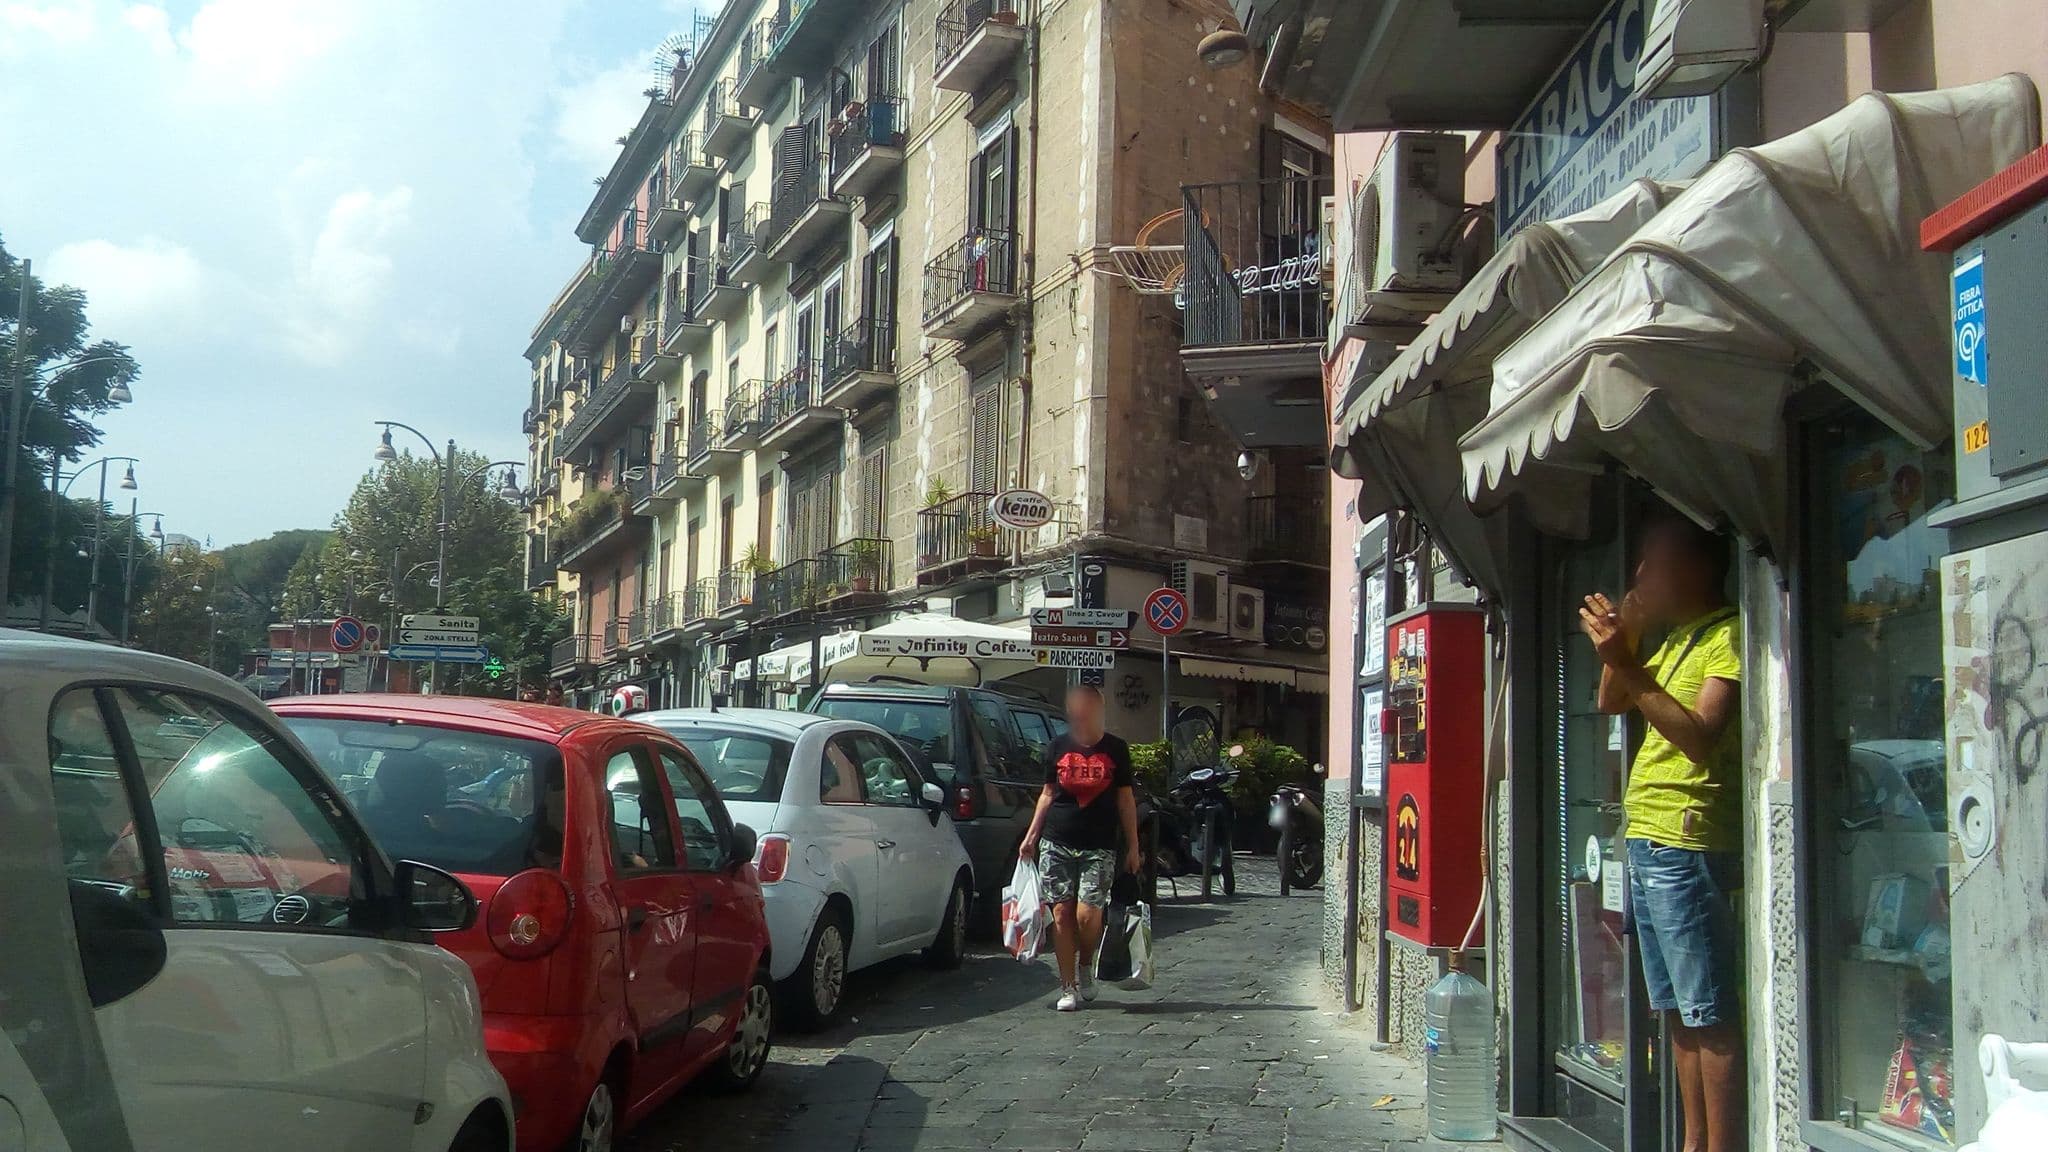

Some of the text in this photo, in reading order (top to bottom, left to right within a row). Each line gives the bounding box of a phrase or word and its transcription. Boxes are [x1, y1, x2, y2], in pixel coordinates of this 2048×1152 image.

[1503, 0, 1643, 220] TABACC
[1619, 119, 1657, 182] BOLLO
[1660, 97, 1698, 143] AUTO
[1540, 163, 1575, 221] POSTALI
[1587, 110, 1626, 175] VALORI
[1959, 284, 1981, 306] FIBRA
[1957, 298, 1984, 321] OTTICA
[1966, 422, 1988, 451] 122
[1000, 497, 1048, 519] kenon
[1049, 611, 1062, 623] M
[1034, 631, 1059, 641] Teatro
[1038, 650, 1104, 667] P PARCHEGGIO
